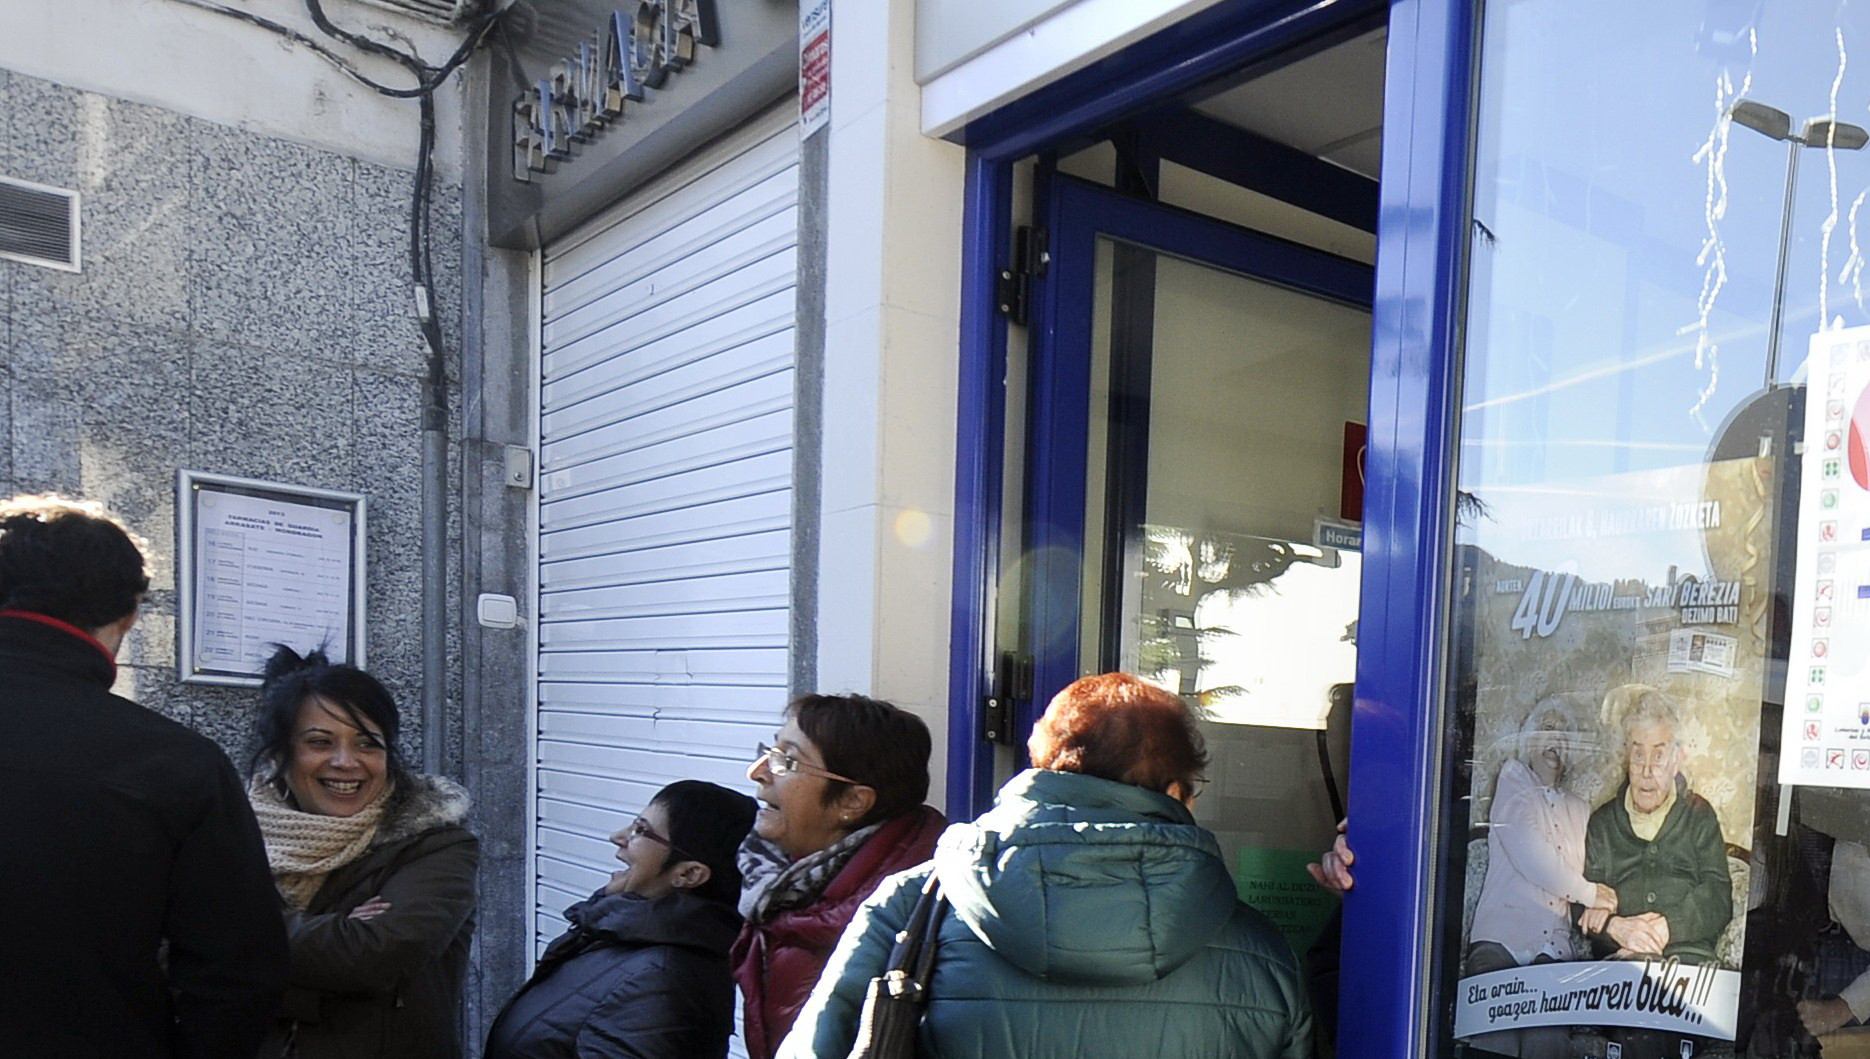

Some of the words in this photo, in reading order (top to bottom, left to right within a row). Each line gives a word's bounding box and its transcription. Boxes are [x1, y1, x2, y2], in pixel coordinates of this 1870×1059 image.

[1669, 500, 1721, 531] ZOZKETA
[1568, 583, 1615, 612] MILIOI
[1644, 584, 1678, 609] SARI
[1679, 580, 1741, 607] BEREZIA
[1488, 1000, 1538, 1024] goazen
[1539, 978, 1637, 1015] haurraren
[1491, 976, 1538, 998] orain...
